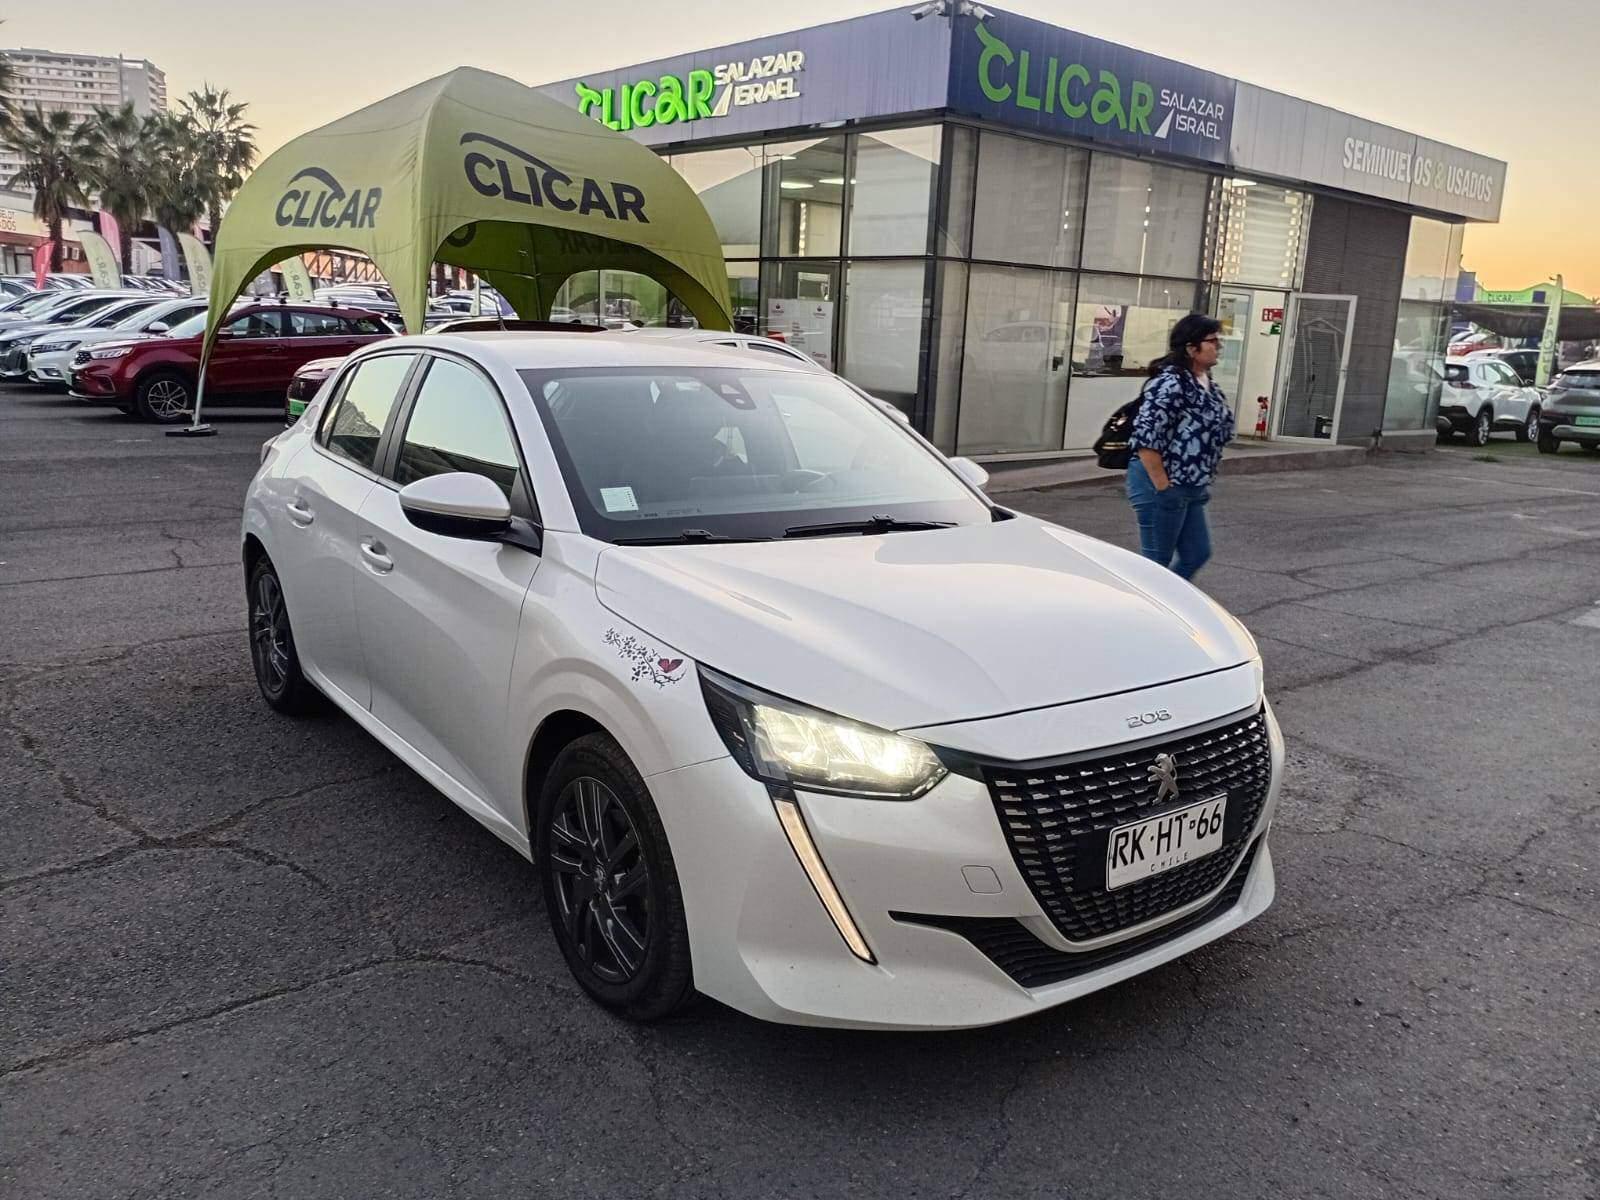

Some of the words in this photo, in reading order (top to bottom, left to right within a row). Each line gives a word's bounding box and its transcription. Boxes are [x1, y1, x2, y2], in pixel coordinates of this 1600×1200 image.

[713, 50, 804, 86] SALAZAR
[734, 77, 801, 106] ISRAEL
[1160, 88, 1225, 121] SALAZAR
[1175, 113, 1221, 140] ISRAEL
[463, 152, 650, 224] CLICAR
[1446, 165, 1493, 202] USADOS
[275, 186, 382, 229] CLICAR
[1126, 709, 1172, 728] 208
[1150, 851, 1188, 872] CHILE
